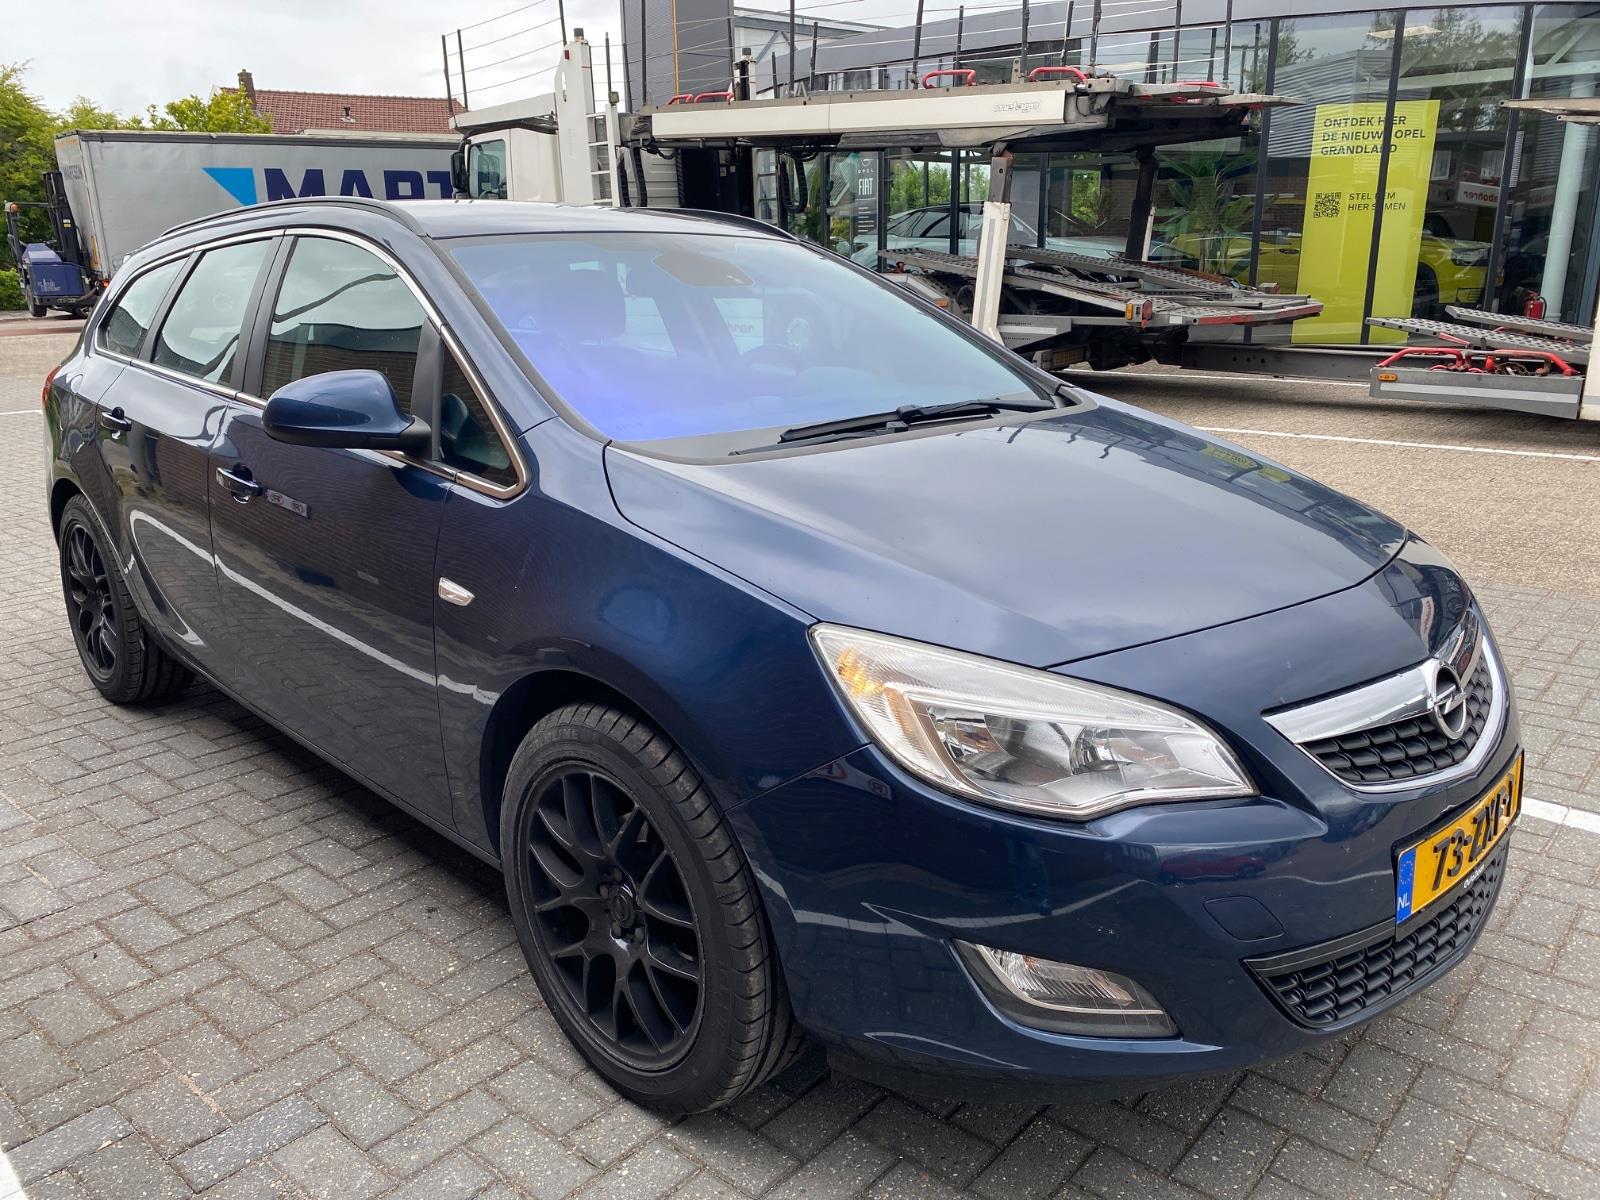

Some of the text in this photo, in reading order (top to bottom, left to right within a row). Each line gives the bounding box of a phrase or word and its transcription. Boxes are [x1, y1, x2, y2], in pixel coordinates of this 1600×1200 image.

[1323, 116, 1407, 128] ONTDEK HER
[1322, 129, 1426, 142] DE NIEUW OPEL
[1320, 144, 1398, 155] GRANDLAD
[858, 177, 874, 196] FIAT
[1349, 192, 1372, 201] STEL
[1347, 202, 1407, 211] HIER SMEN
[1397, 892, 1411, 912] NL
